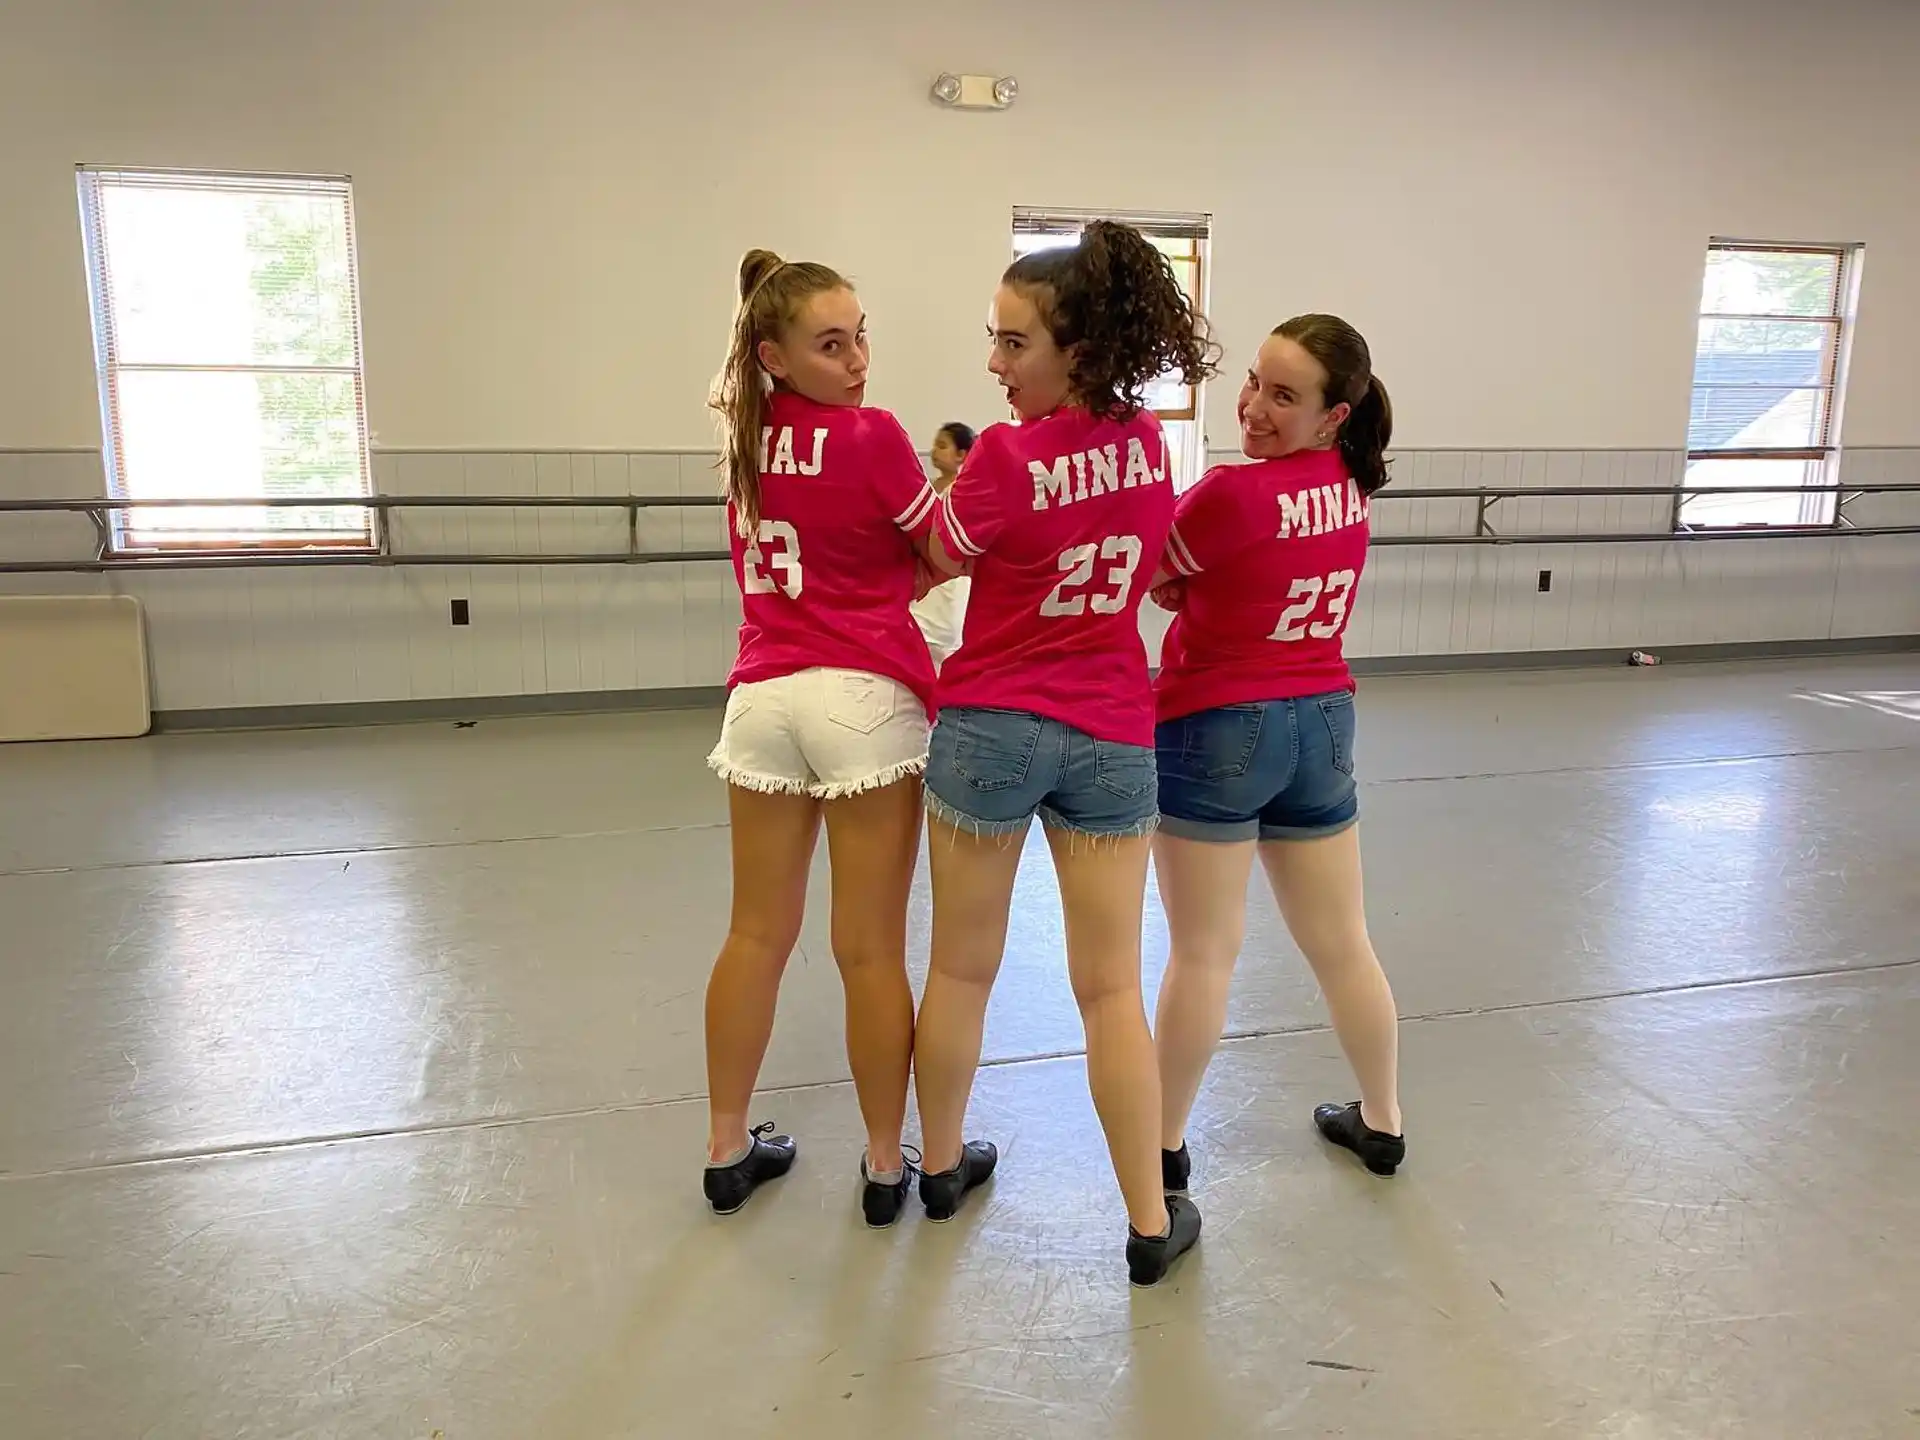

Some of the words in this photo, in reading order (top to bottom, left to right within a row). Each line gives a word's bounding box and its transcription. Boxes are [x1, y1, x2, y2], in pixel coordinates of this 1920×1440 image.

[1027, 430, 1166, 511] MINAJ
[1039, 535, 1142, 617] 23
[1266, 568, 1356, 641] 23
